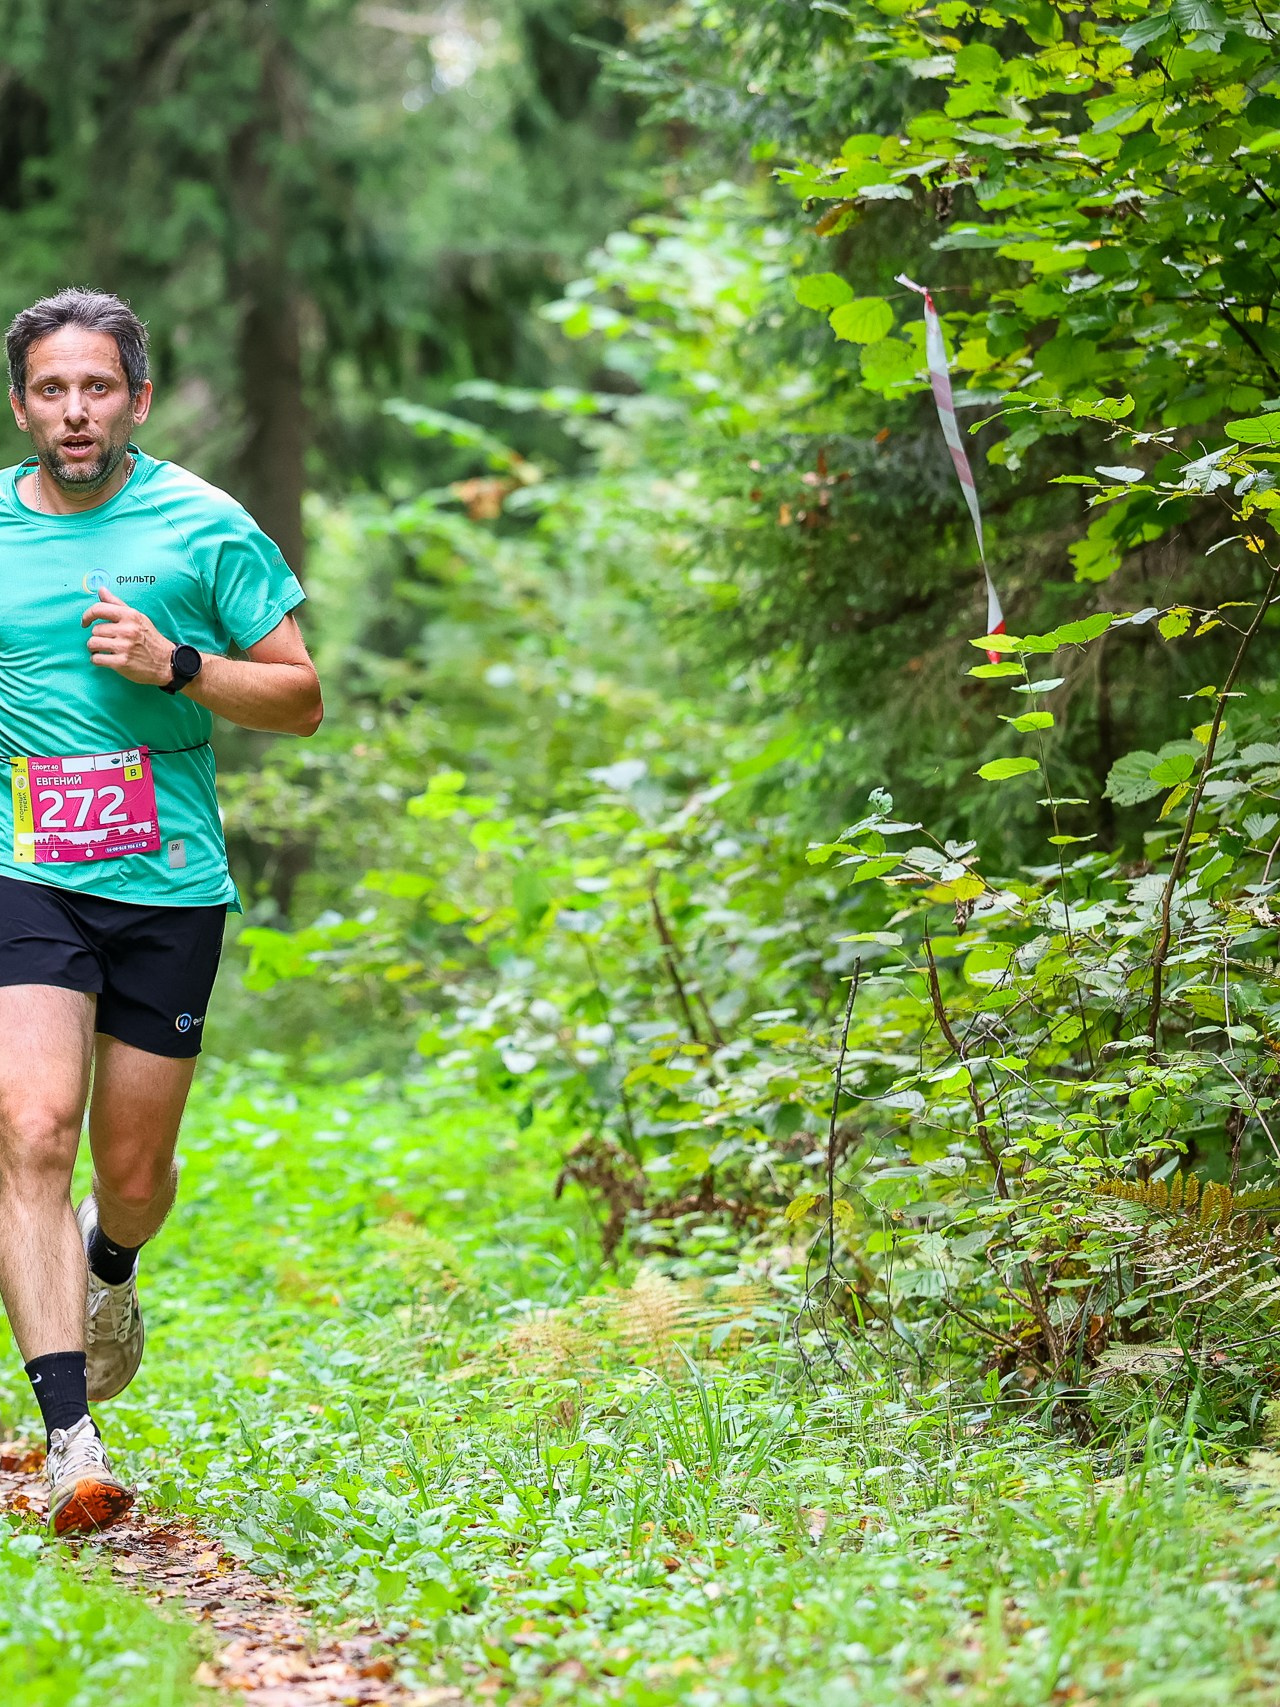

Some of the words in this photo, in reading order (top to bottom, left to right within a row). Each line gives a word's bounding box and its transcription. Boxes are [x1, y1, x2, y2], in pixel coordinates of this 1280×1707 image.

[116, 575, 156, 586] фильтр
[36, 774, 82, 786] ЕВГЕНИЙ
[38, 785, 128, 828] 272
